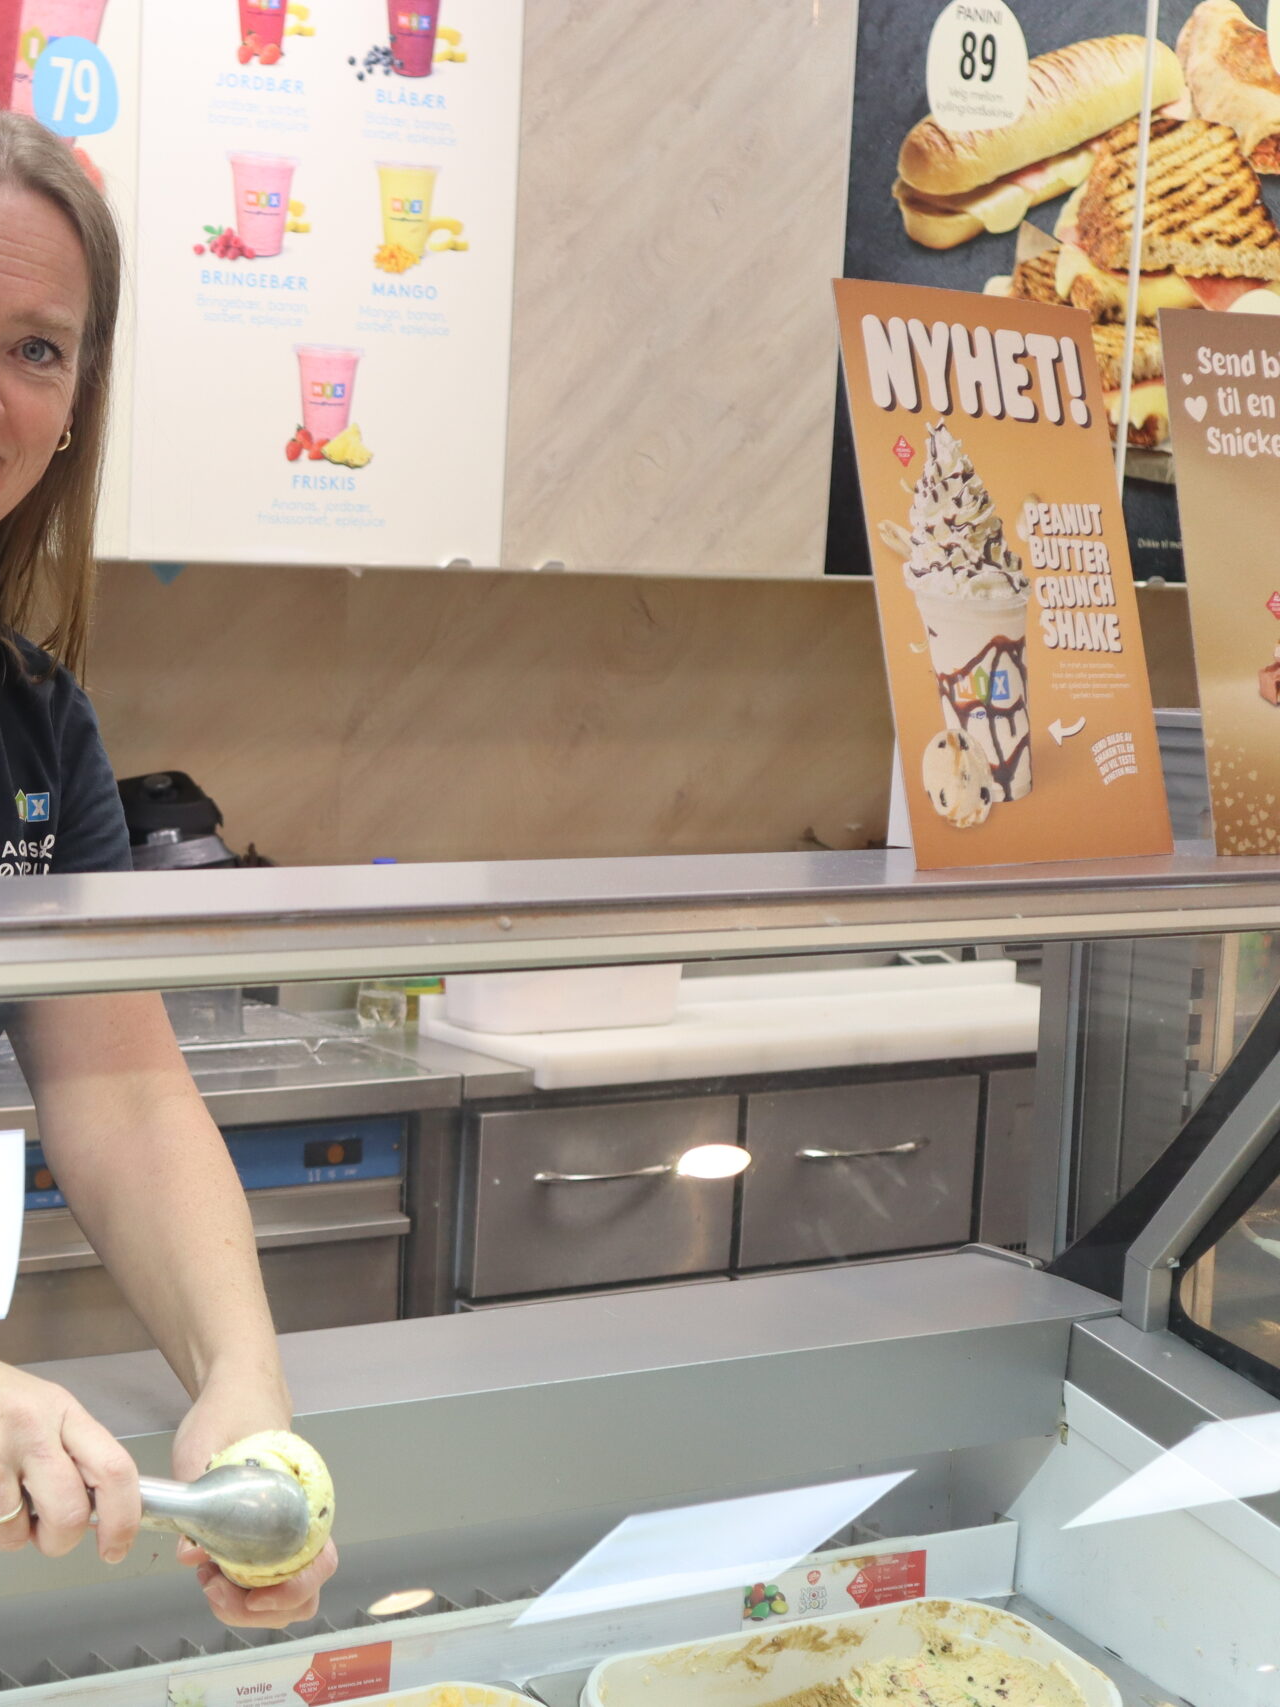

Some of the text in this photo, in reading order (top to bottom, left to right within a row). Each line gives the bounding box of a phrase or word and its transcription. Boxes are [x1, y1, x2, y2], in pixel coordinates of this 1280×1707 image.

[956, 5, 1003, 25] PANINI
[960, 31, 997, 82] 89
[50, 56, 100, 124] 79
[215, 73, 305, 94] JORDBÆR
[375, 88, 447, 109] BLÅBÆR
[201, 270, 308, 290] BRINGEBÆR
[371, 283, 438, 300] MANGO
[862, 313, 1092, 428] NYHET!
[1197, 346, 1280, 379] Send b
[1217, 386, 1275, 419] til en
[292, 474, 356, 491] FRISKIS
[1025, 502, 1103, 538] PEANUT
[1029, 534, 1111, 574] BUTTER
[1034, 575, 1117, 610] CRUNCH
[1040, 609, 1123, 654] SHAKE
[236, 1682, 272, 1697] Vanilje
